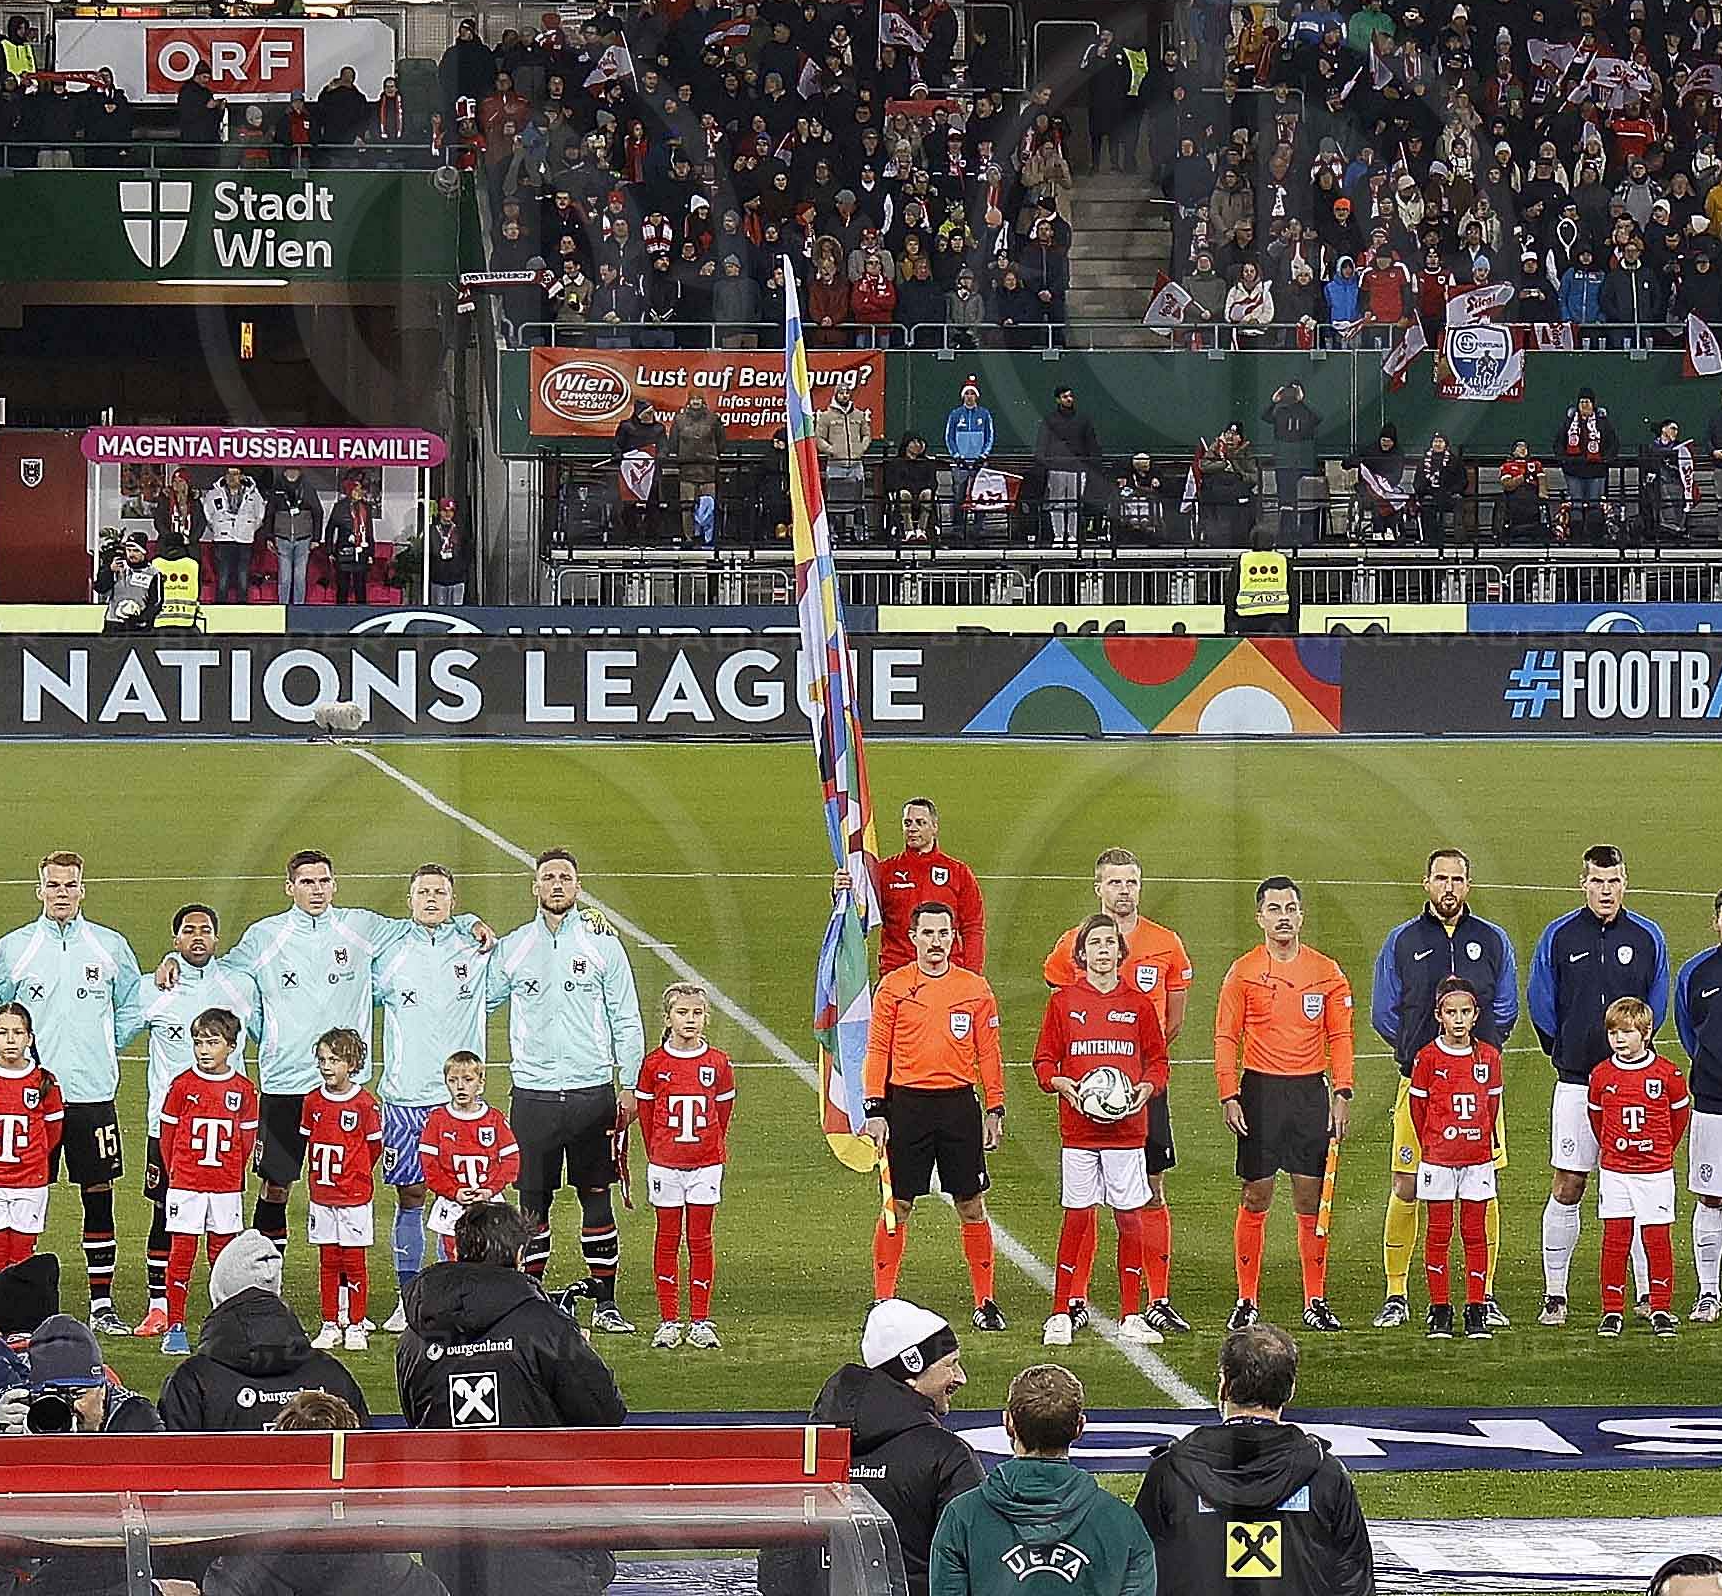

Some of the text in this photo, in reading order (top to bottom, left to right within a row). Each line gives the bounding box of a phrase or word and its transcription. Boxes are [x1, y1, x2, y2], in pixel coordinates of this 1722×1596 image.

[158, 41, 293, 81] ORF
[214, 180, 334, 223] Stadt
[214, 227, 334, 269] Wien
[554, 374, 614, 391] Wien
[636, 365, 688, 386] Lust
[692, 363, 735, 391] auf
[718, 394, 787, 409] Infos unte
[97, 433, 430, 461] MAGENTA FUSSBALL FAMILIE
[22, 649, 484, 723] NATIONS
[94, 1124, 118, 1159] 15
[1007, 1548, 1083, 1581] UEFA
